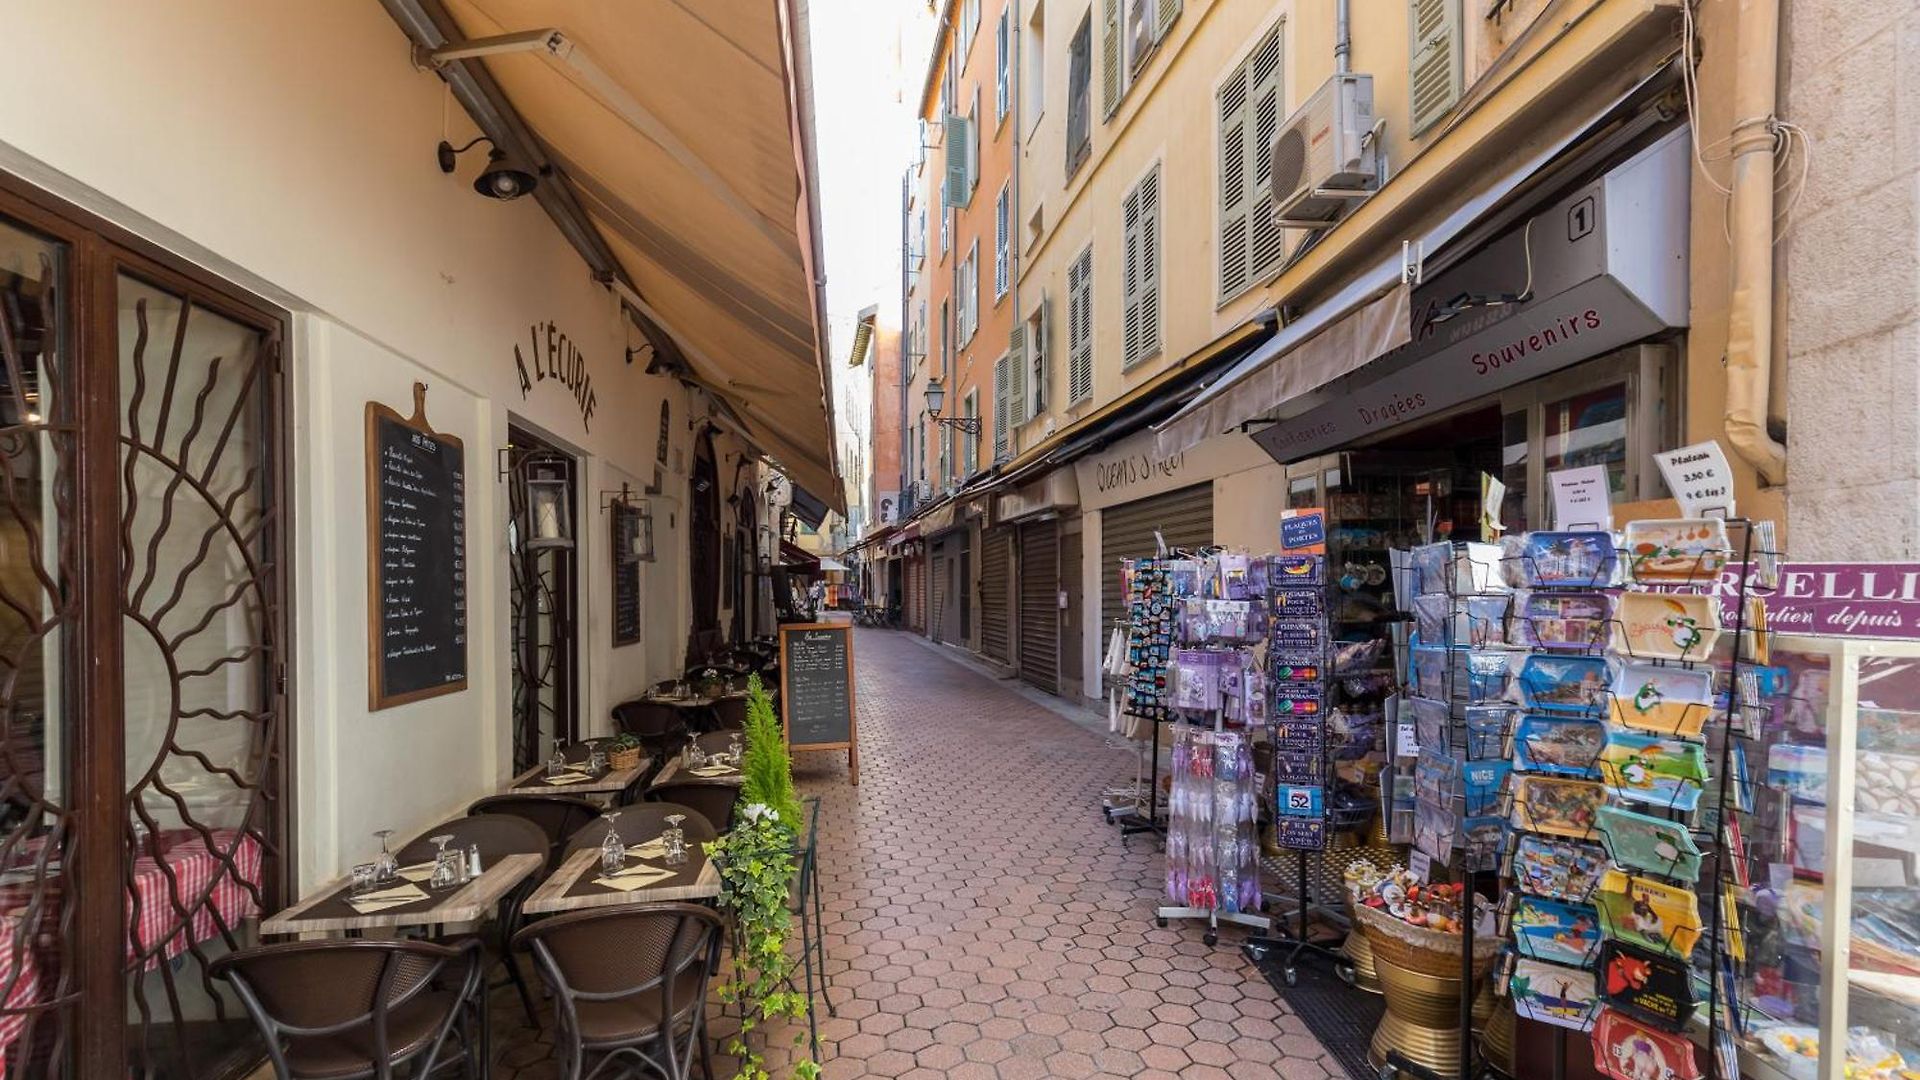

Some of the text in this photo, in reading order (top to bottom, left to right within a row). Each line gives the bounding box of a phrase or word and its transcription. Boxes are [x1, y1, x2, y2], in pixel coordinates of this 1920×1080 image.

[1573, 207, 1587, 233] 1
[1471, 307, 1601, 376] Souvenirs
[514, 343, 532, 401] A
[1358, 391, 1426, 426] Dragées
[1705, 469, 1715, 479] €
[1695, 490, 1704, 499] €
[1827, 606, 1903, 632] depuis
[1470, 769, 1495, 782] NICE
[1290, 795, 1309, 809] 52
